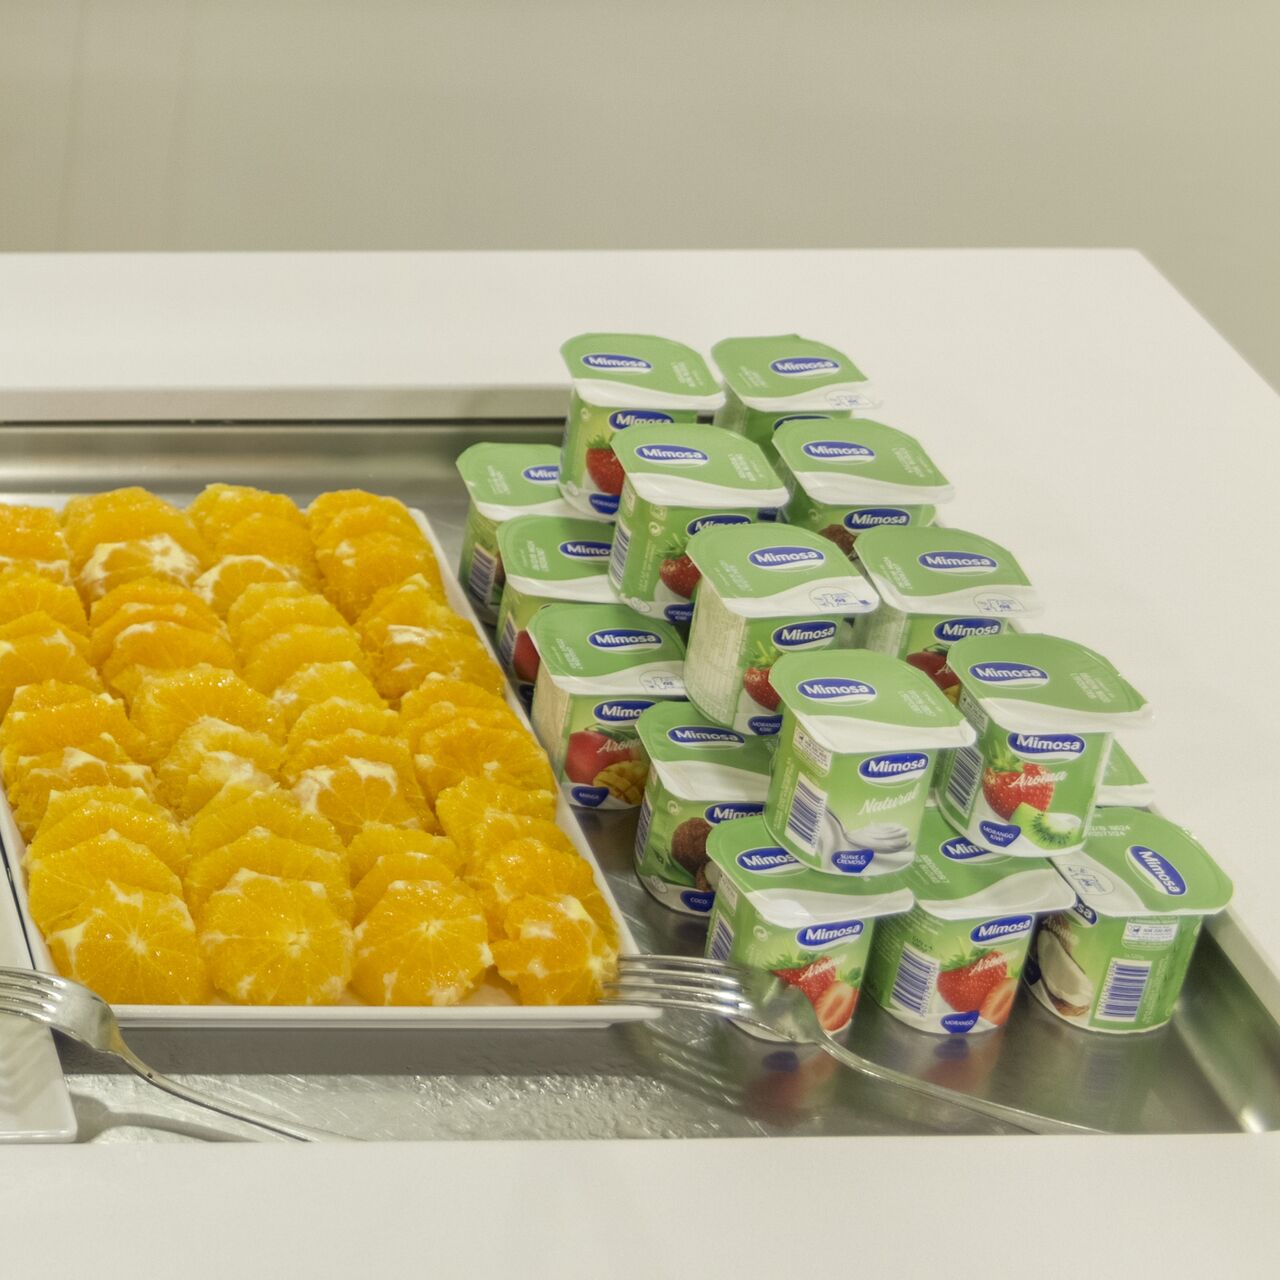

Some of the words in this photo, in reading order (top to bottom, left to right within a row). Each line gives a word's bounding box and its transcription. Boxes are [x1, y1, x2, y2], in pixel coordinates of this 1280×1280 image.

[589, 356, 647, 368] Mimosa
[776, 360, 834, 371] Mimosa
[642, 447, 702, 460] Mimosa
[809, 445, 868, 456] Mimosa
[529, 469, 558, 480] Mim
[851, 513, 907, 525] Mimosa
[567, 543, 611, 555] Mimo
[755, 550, 818, 563] Mimosa
[925, 555, 991, 567] Mimosa
[781, 627, 835, 641] Mimosa
[942, 624, 999, 636] Mimosa
[595, 632, 657, 645] Mimosa
[975, 667, 1041, 678] Mimosa
[804, 683, 869, 696] Mimosa
[602, 704, 642, 718] Mimo
[675, 730, 739, 742] Mimosa
[1016, 734, 1081, 751] Mimosa
[868, 757, 926, 773] Mimosa
[857, 782, 921, 816] Natural
[983, 826, 1014, 840] MORANGO
[948, 842, 986, 856] Mim
[742, 854, 796, 867] Mimos
[836, 858, 867, 866] CREMOSO
[1139, 849, 1181, 893] Mimosa
[690, 896, 709, 904] COCO
[806, 924, 860, 941] Mimosa
[979, 920, 1031, 938] Mimosa
